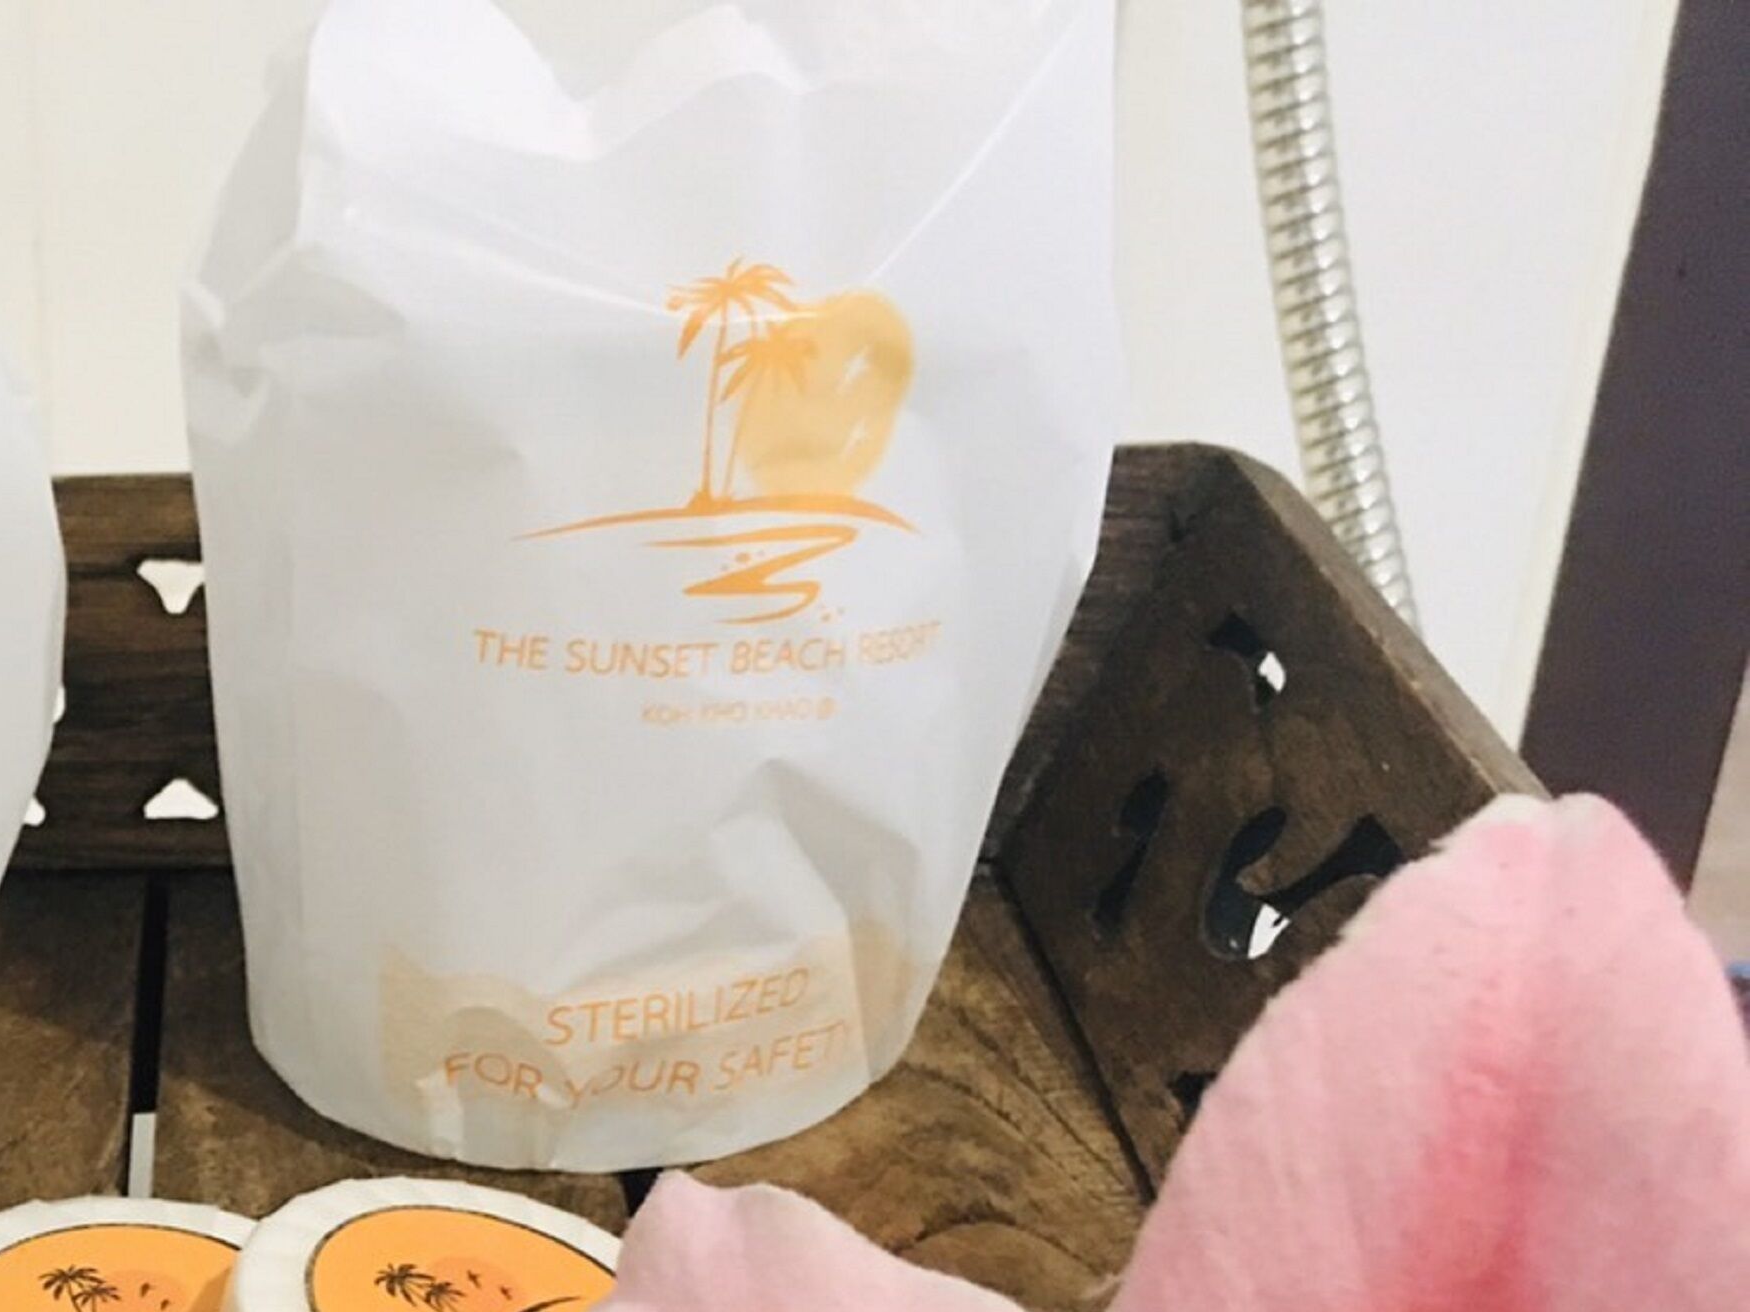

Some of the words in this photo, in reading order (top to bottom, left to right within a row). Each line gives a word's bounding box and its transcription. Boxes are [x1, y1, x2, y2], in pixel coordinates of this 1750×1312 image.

[474, 630, 549, 671] THE
[565, 639, 720, 678] SUNSET
[730, 637, 845, 674] BEACH
[543, 967, 810, 1046] STERILIZED
[443, 1051, 544, 1100] FOR
[563, 1059, 701, 1109] YOUR
